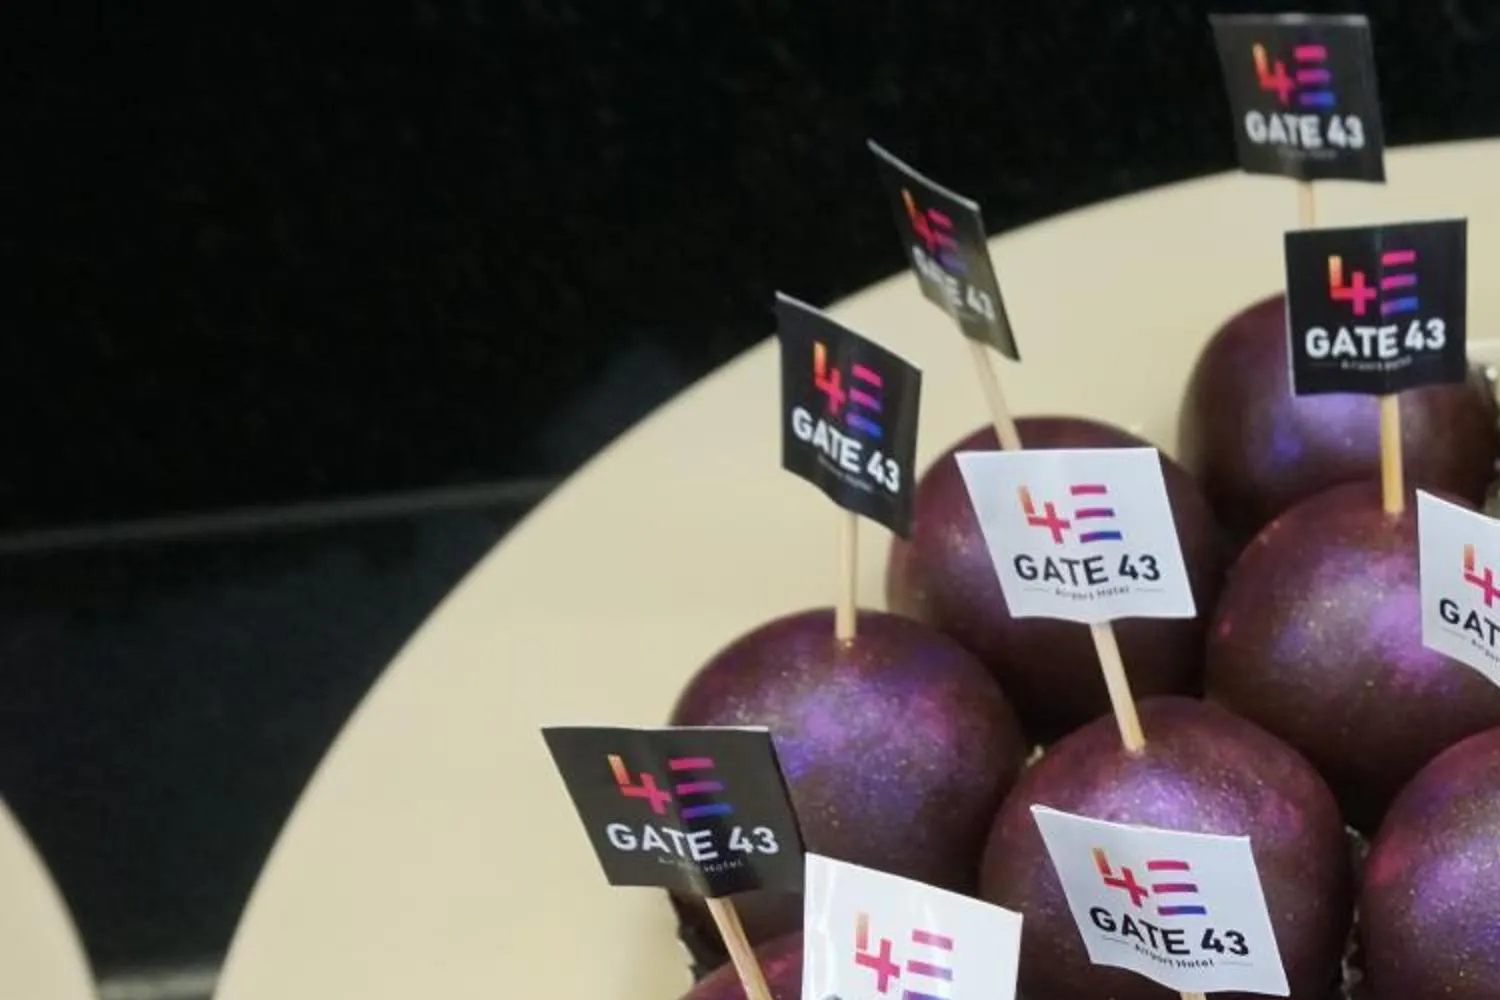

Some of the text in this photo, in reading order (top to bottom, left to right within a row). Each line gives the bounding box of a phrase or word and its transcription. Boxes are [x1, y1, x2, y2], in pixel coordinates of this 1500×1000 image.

[1245, 110, 1365, 148] GATE 43
[1305, 317, 1446, 358] GATE 43
[792, 407, 862, 473] GATE
[867, 451, 900, 493] 43
[1014, 554, 1160, 585] GATE 43
[607, 824, 779, 861] GATE 43
[1089, 907, 1249, 956] GATE 43
